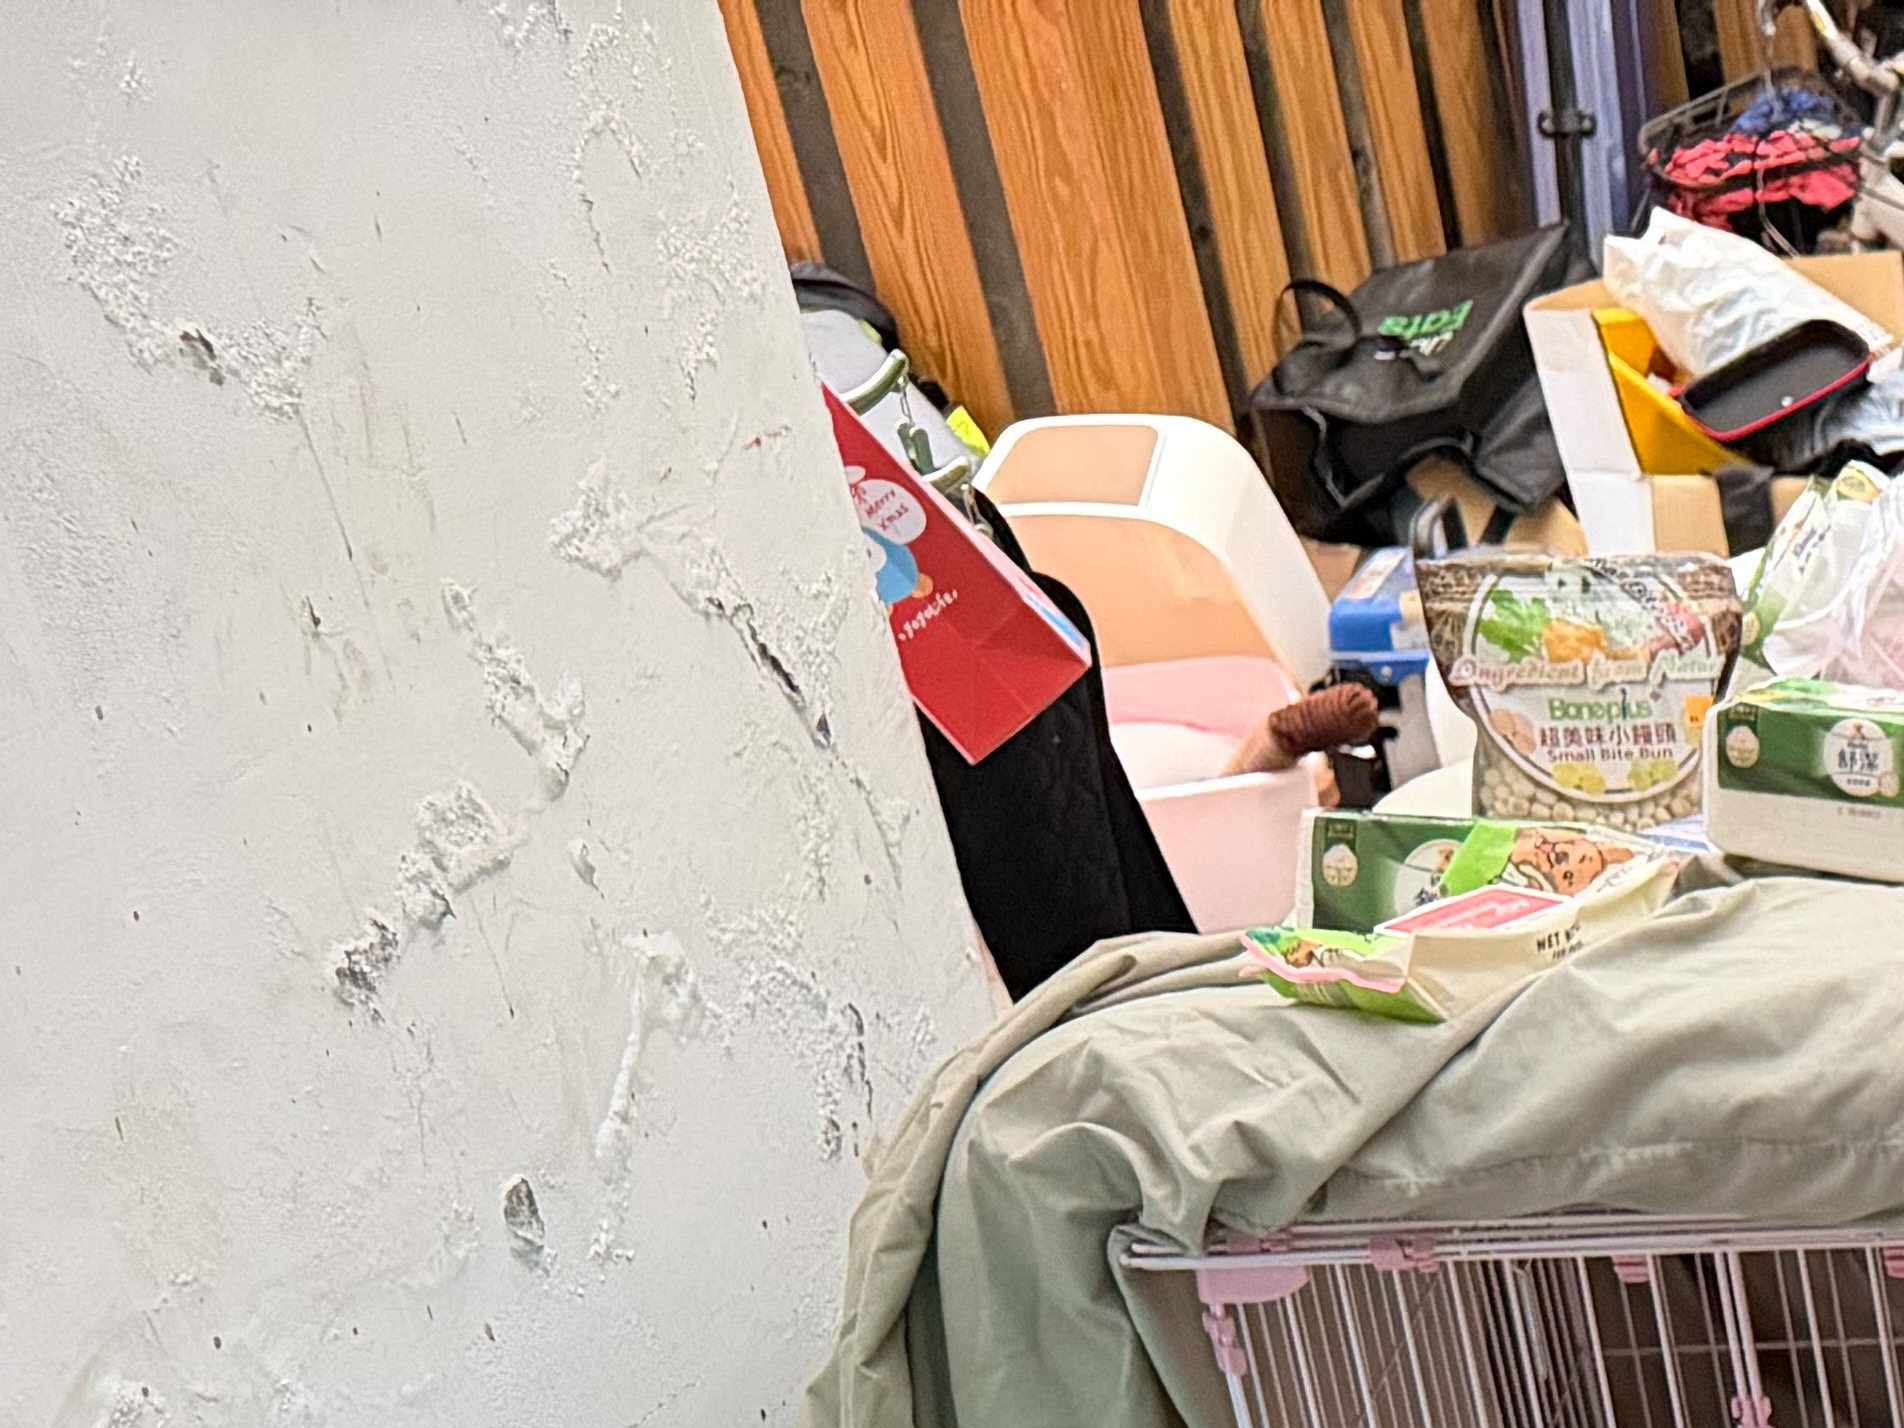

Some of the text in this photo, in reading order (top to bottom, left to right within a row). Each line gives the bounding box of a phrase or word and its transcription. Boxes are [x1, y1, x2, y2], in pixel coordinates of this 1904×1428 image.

[1547, 747, 1673, 763] Small Bite Bun
